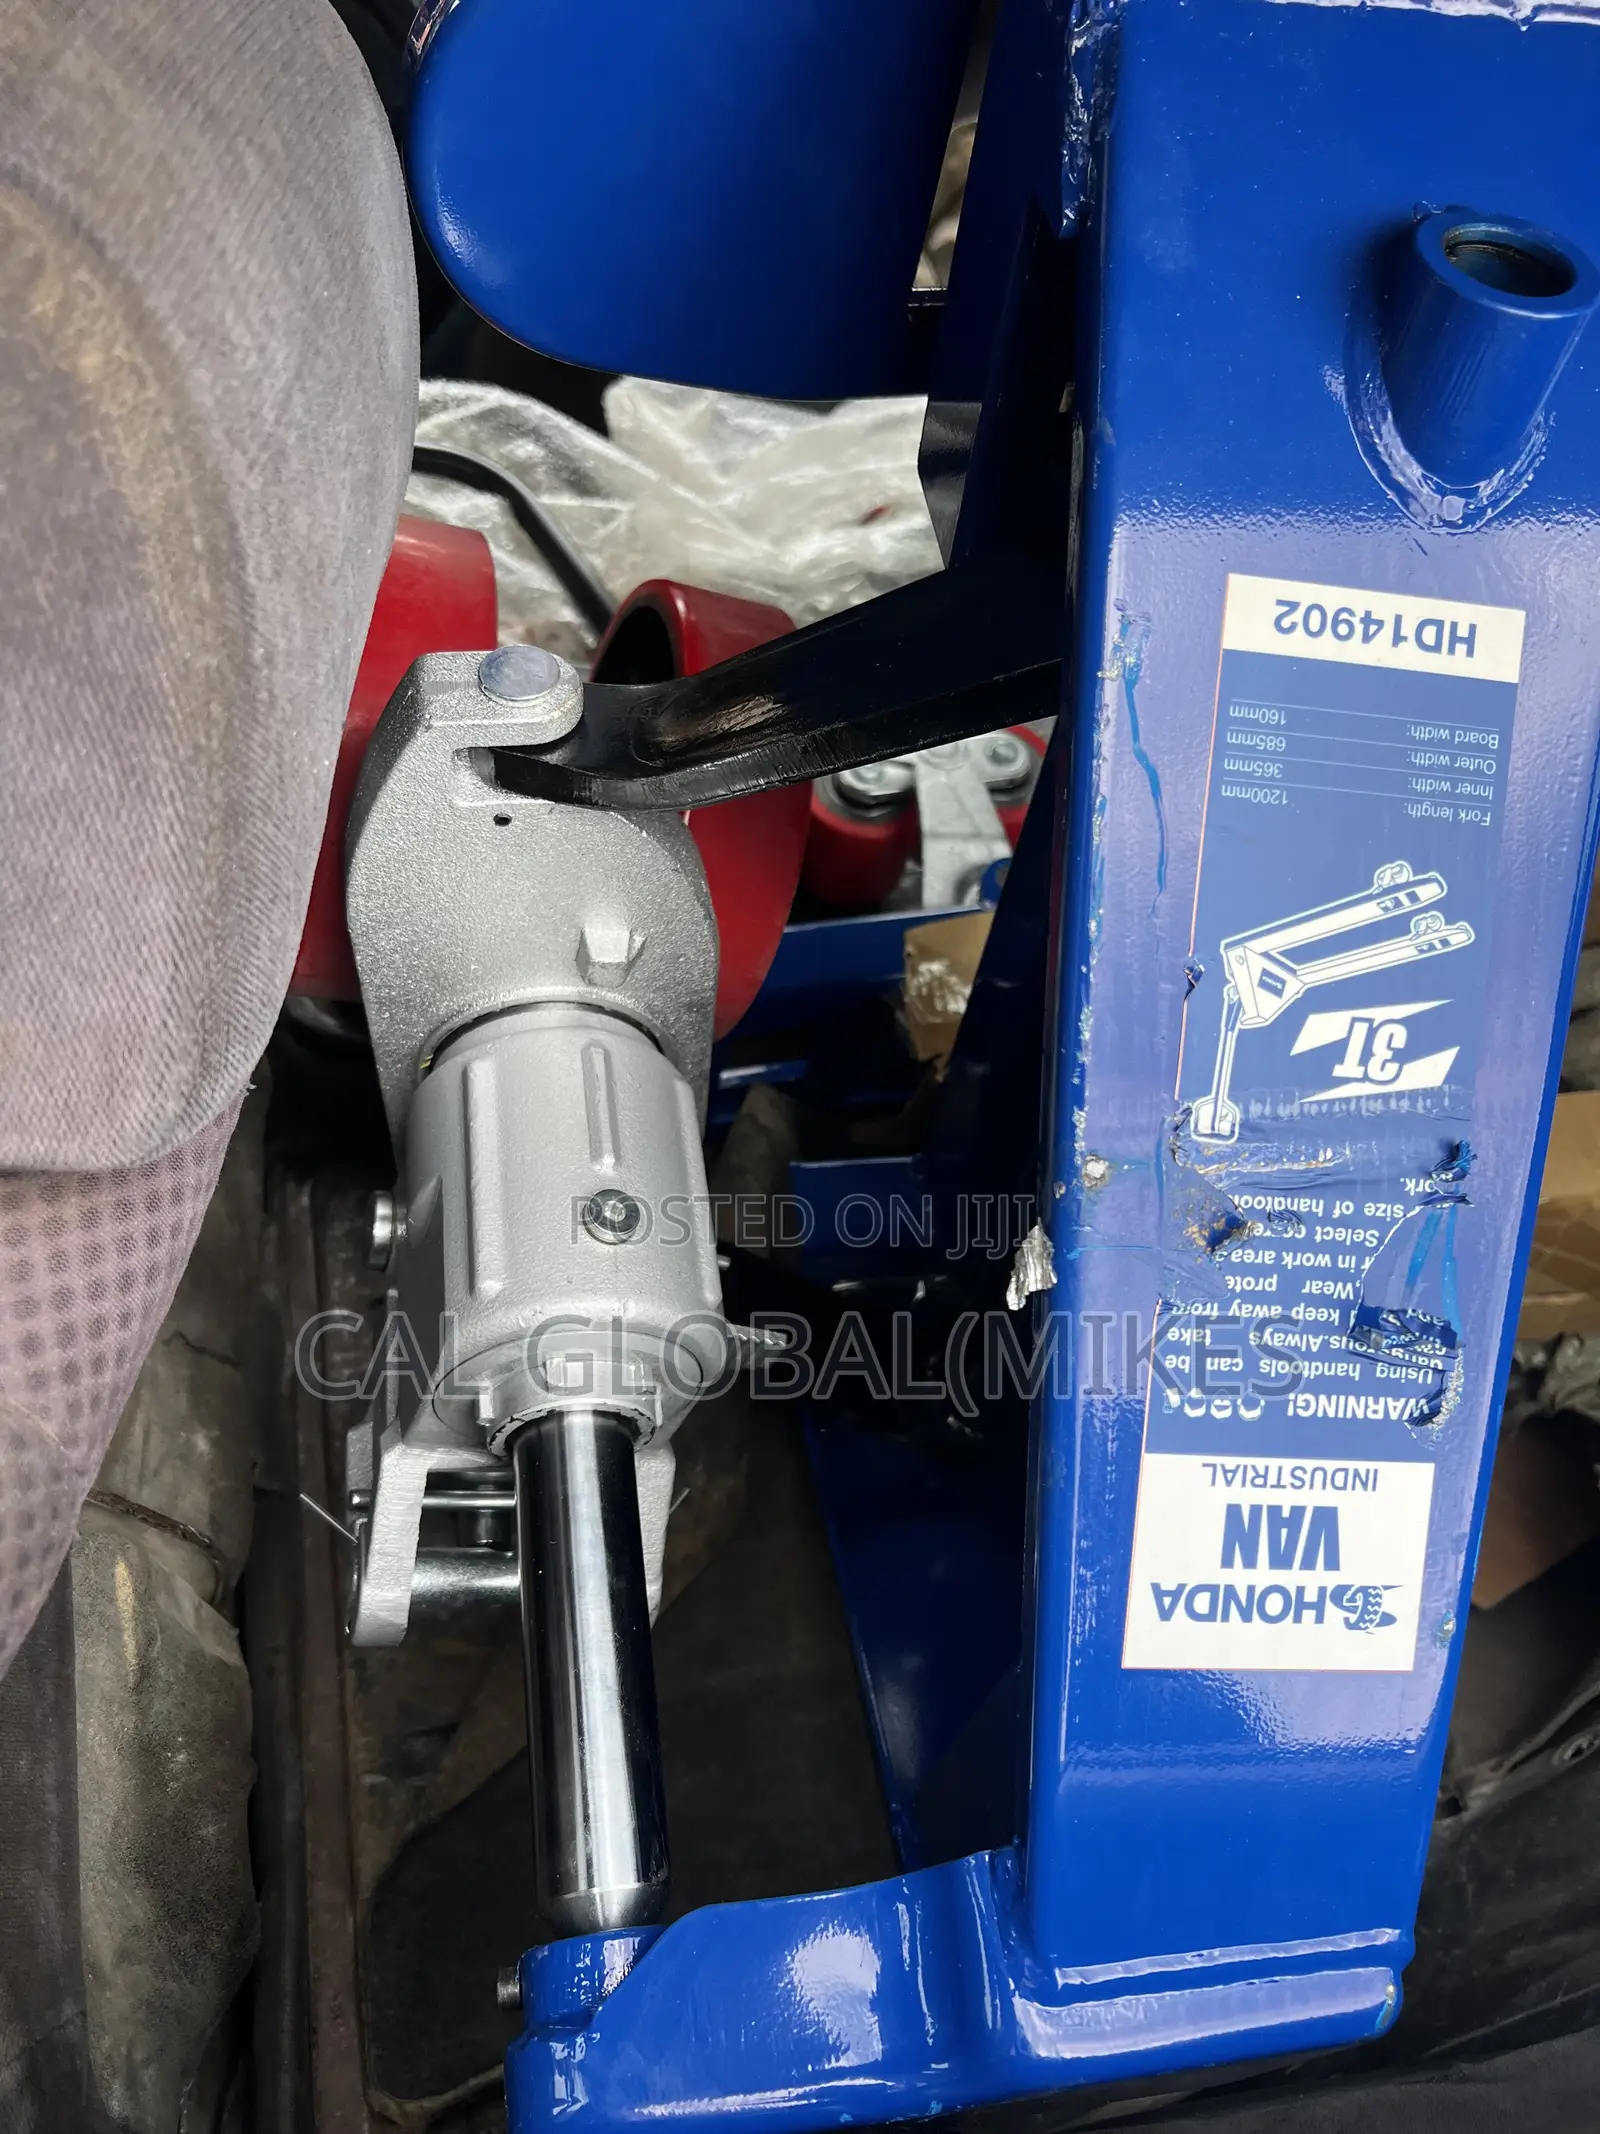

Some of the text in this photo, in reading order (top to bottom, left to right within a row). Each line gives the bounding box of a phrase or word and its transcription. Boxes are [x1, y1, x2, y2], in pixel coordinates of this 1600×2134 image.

[1273, 599, 1477, 658] HD14902
[1229, 704, 1499, 749] Board width: 160mm
[1227, 731, 1496, 775] Outer width: 685mm
[1224, 757, 1493, 800] Inner width: 365mm
[1221, 784, 1491, 826] Fork length: 1200mm
[1332, 1018, 1408, 1082] 3T
[1332, 1202, 1354, 1218] of
[1364, 1202, 1404, 1218] size
[1314, 1223, 1380, 1246] Select
[1231, 1249, 1277, 1265] area
[1281, 1250, 1332, 1269] work
[1338, 1256, 1358, 1273] in
[1225, 1275, 1278, 1292] prote
[1228, 1298, 1282, 1318] away
[1291, 1305, 1340, 1323] keep
[1167, 1328, 1211, 1346] take
[1165, 1354, 1434, 1384] Using handtools can be
[1287, 1393, 1431, 1420] WARNING!
[1201, 1463, 1379, 1491] INDUSTRIAL
[1220, 1503, 1341, 1571] VAN
[1150, 1582, 1328, 1624] HONDA
